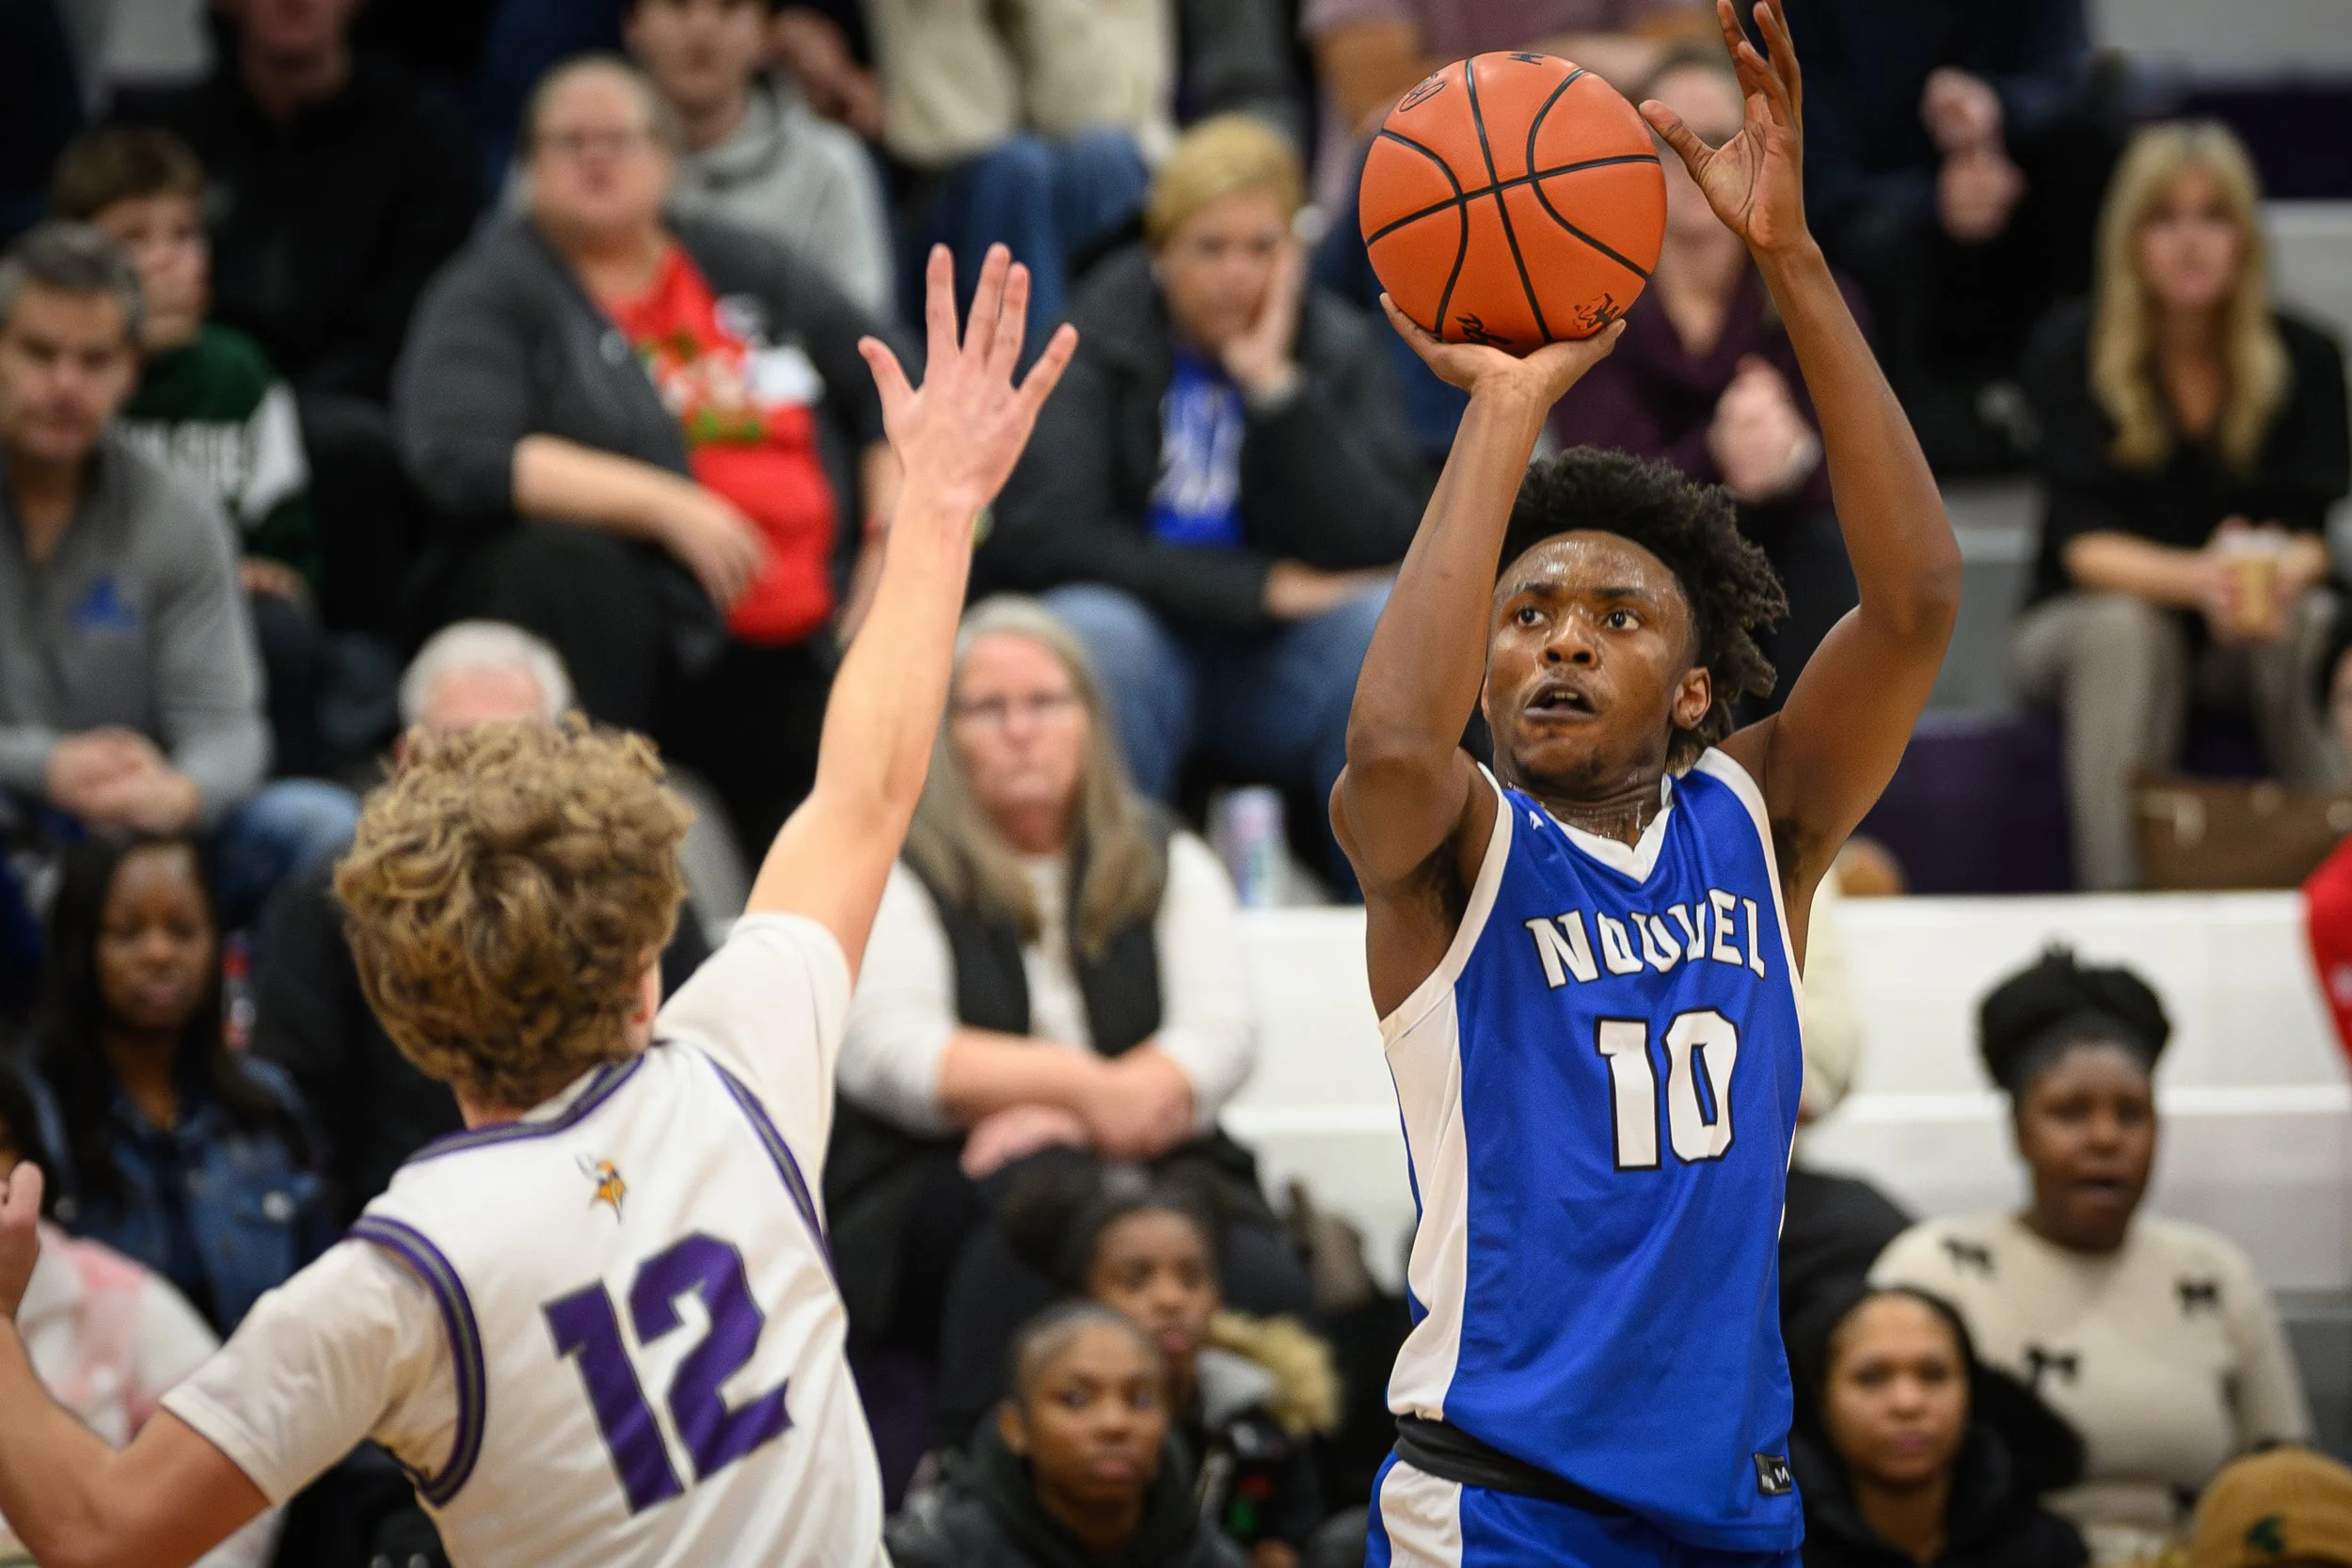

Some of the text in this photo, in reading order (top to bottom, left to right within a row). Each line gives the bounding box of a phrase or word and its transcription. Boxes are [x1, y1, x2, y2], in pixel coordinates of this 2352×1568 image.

[1523, 888, 1766, 990] NOUVEL
[1594, 1006, 1740, 1173] 10
[540, 1229, 795, 1515] 12
